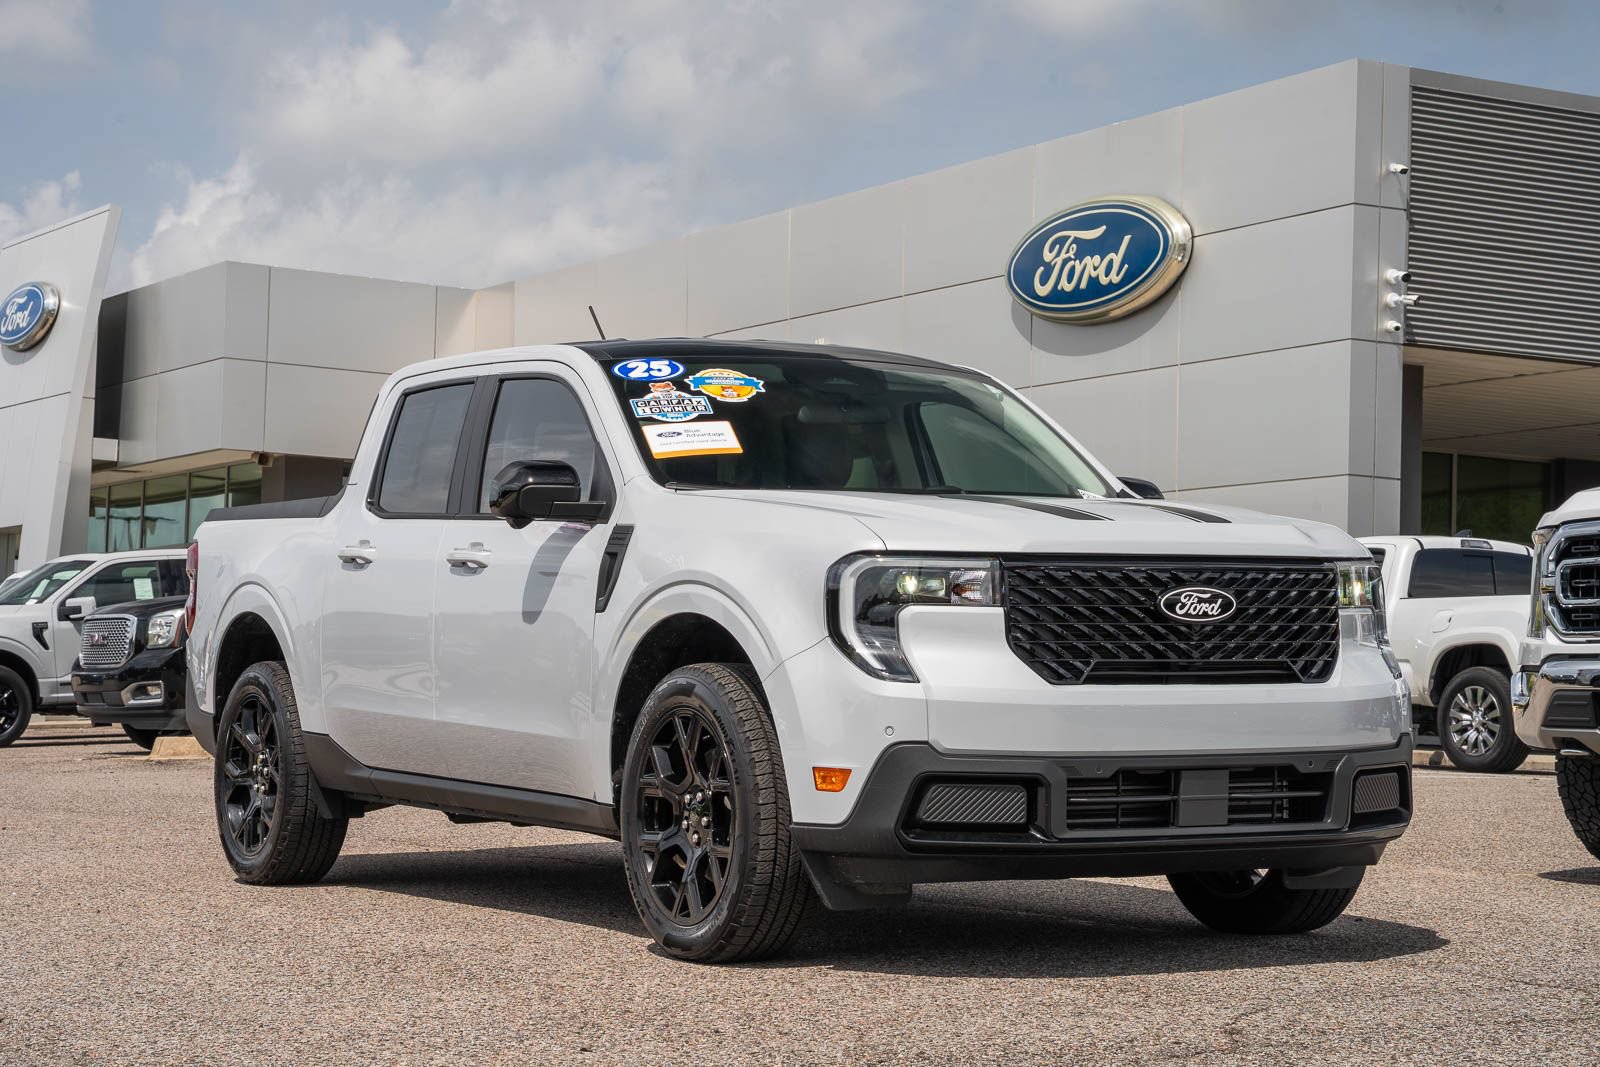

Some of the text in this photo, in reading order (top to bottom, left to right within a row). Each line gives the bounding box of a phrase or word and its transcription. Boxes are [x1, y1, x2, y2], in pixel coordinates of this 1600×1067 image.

[1033, 225, 1132, 297] Ford
[0, 296, 34, 334] Ford
[626, 360, 672, 378] 25
[636, 398, 703, 408] CARFAX
[651, 405, 707, 413] OWNER
[1175, 592, 1222, 616] Ford
